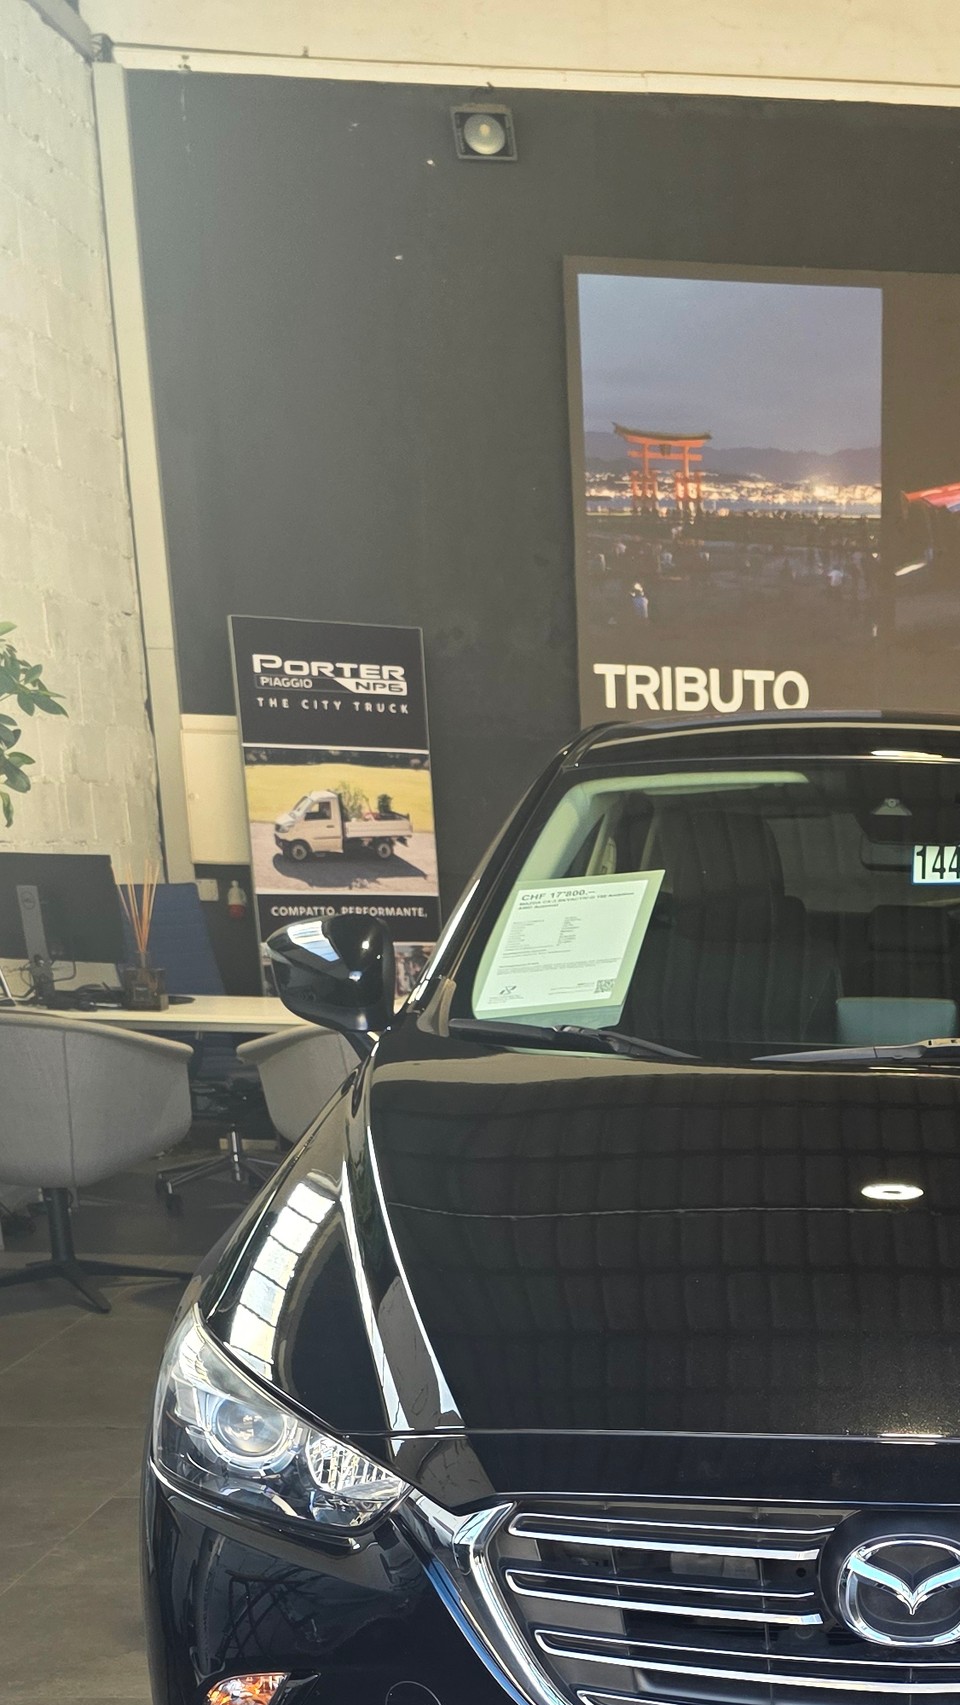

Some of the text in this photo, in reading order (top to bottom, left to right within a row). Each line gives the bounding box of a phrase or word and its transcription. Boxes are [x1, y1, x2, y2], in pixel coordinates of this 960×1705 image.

[252, 654, 405, 681] PORTER
[260, 676, 313, 689] PIAGGIO
[593, 663, 809, 713] TRIBUTO
[256, 697, 409, 714] THE CITY TRUCK
[522, 892, 547, 901] CHF
